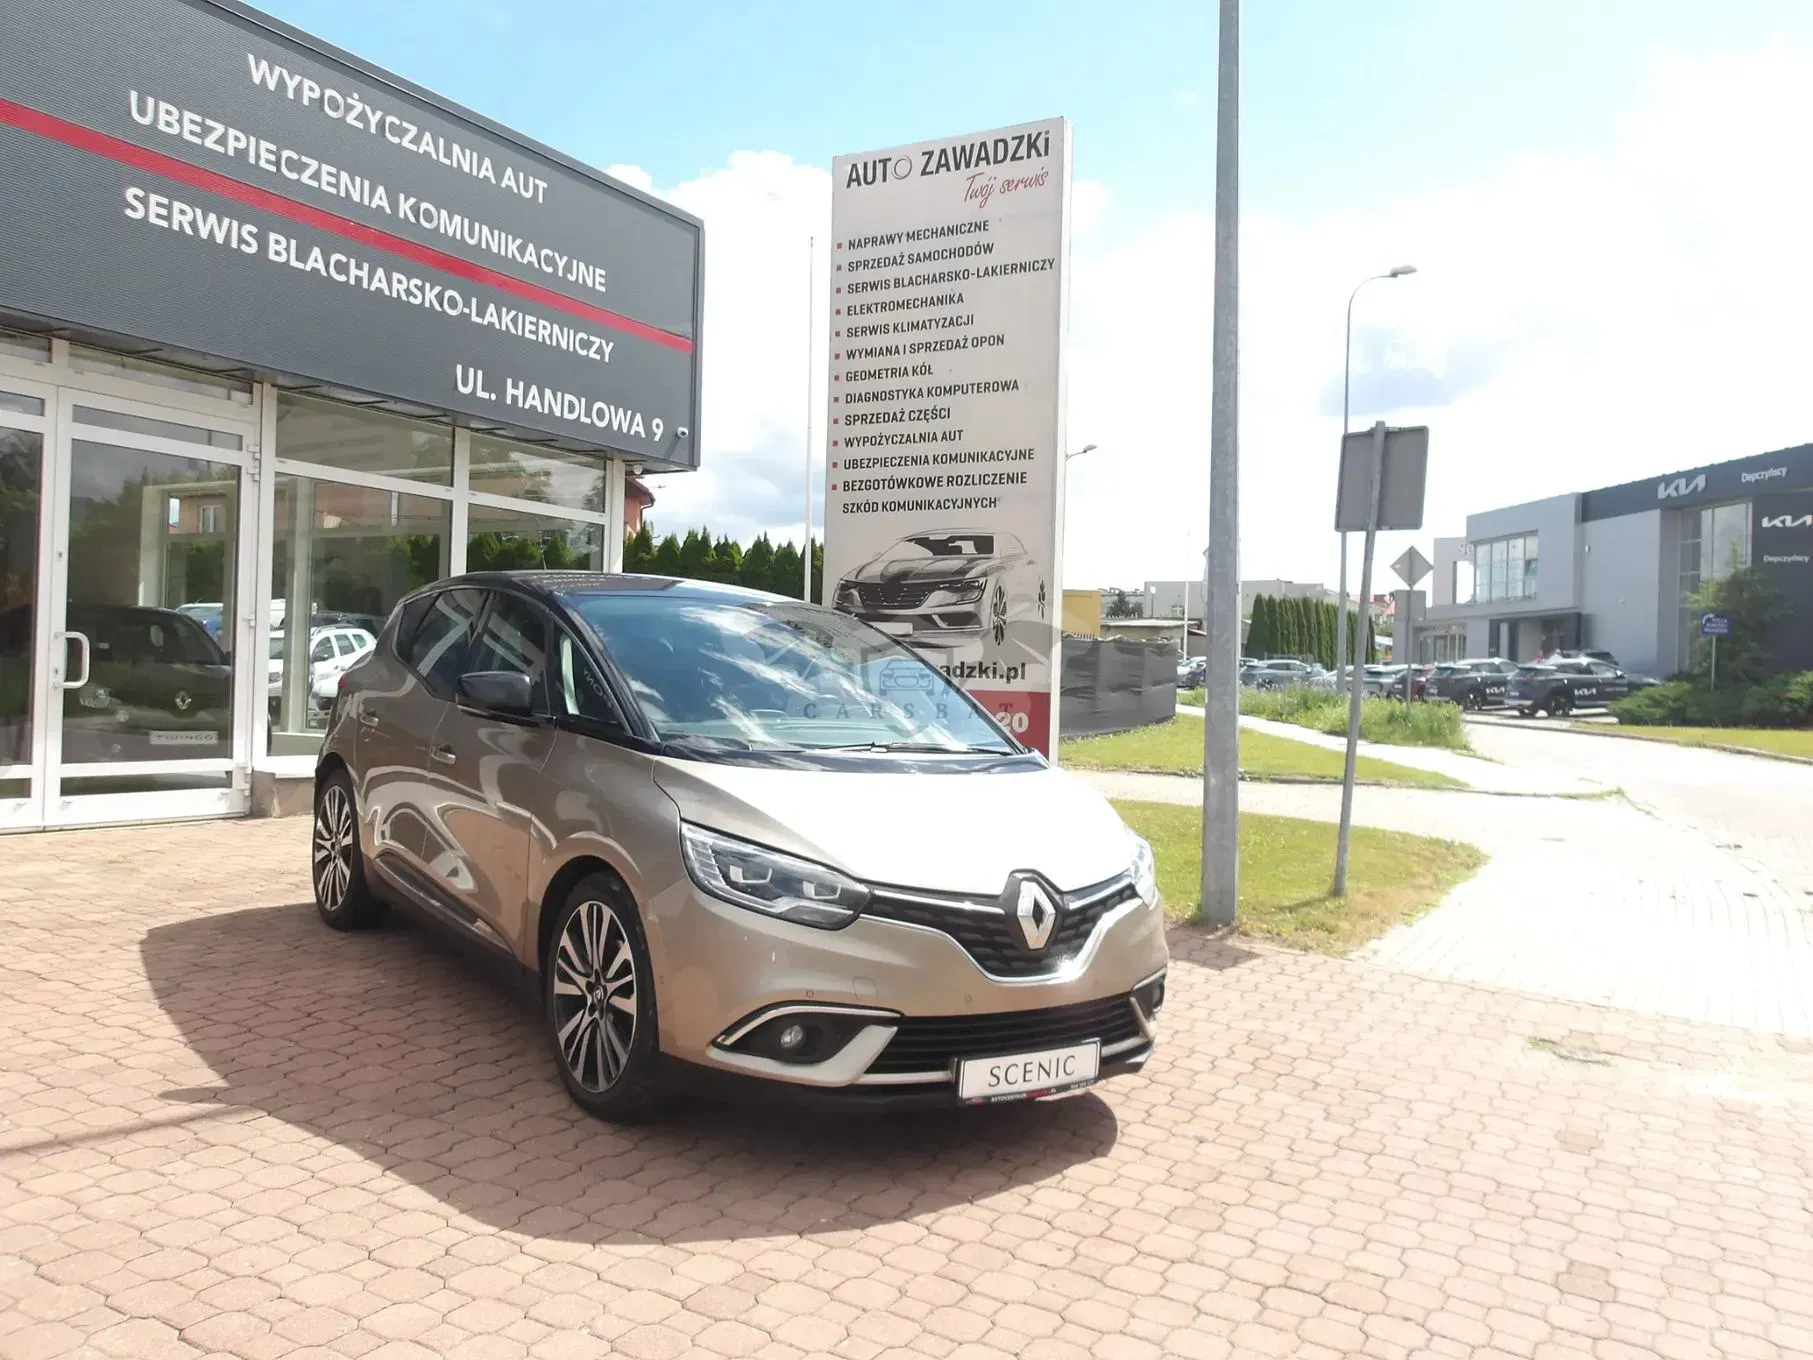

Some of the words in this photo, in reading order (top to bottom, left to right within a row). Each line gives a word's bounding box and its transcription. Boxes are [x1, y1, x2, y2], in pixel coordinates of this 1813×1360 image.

[247, 53, 496, 184] WYPOŻYCZALNIA
[500, 160, 547, 204] AUT
[846, 155, 913, 188] AUTO
[129, 90, 390, 215] UBEZPIECZENIA
[398, 196, 607, 293] KOMUNIKACYJNE
[964, 172, 997, 209] Twój
[848, 232, 904, 250] NAPRAWY
[906, 220, 990, 242] MECHANICZNE
[847, 252, 905, 272] SPRZEDAŻ
[907, 242, 994, 265] SAMOCHODÓW
[124, 187, 258, 254] SERWIS
[267, 232, 614, 363] BLACHARSKO-LAKIERNICZY
[847, 279, 891, 294] SERWIS
[894, 258, 1055, 289] BLACHARSKO-LAKIERNICZY
[846, 292, 965, 316] ELEKTROMECHANIKA
[846, 324, 890, 338] SERWIS
[893, 314, 974, 333] KLIMATYZACJI
[846, 345, 901, 360] WYMIANA
[903, 345, 907, 355] I
[909, 335, 968, 354] SPRZEDAŻ
[971, 334, 1005, 348] OPON
[845, 366, 909, 382] GEOMETRIA
[912, 362, 933, 376] KÓŁ
[455, 364, 496, 401] UL.
[506, 378, 646, 439] HANDLOWA
[651, 417, 664, 442] 9
[845, 387, 924, 404] DIAGNOSTYKA
[927, 379, 1019, 398] KOMPUTEROWA
[844, 408, 905, 426] SPRZEDAŻ
[908, 405, 951, 424] CZĘŚCI
[844, 431, 938, 449] WYPOŻYCZALNIA
[941, 429, 964, 442] AUT
[843, 455, 930, 470] UBEZPIECZENIA
[932, 448, 1035, 466] KOMUNIKACYJNE
[842, 475, 944, 492] BEZGOTÓWKOWE
[946, 472, 1027, 487] ROZLICZENIE
[842, 498, 879, 514] SZKÓD
[881, 497, 997, 513] KOMUNIKACYJNYCH
[988, 1055, 1076, 1088] SCENIC
